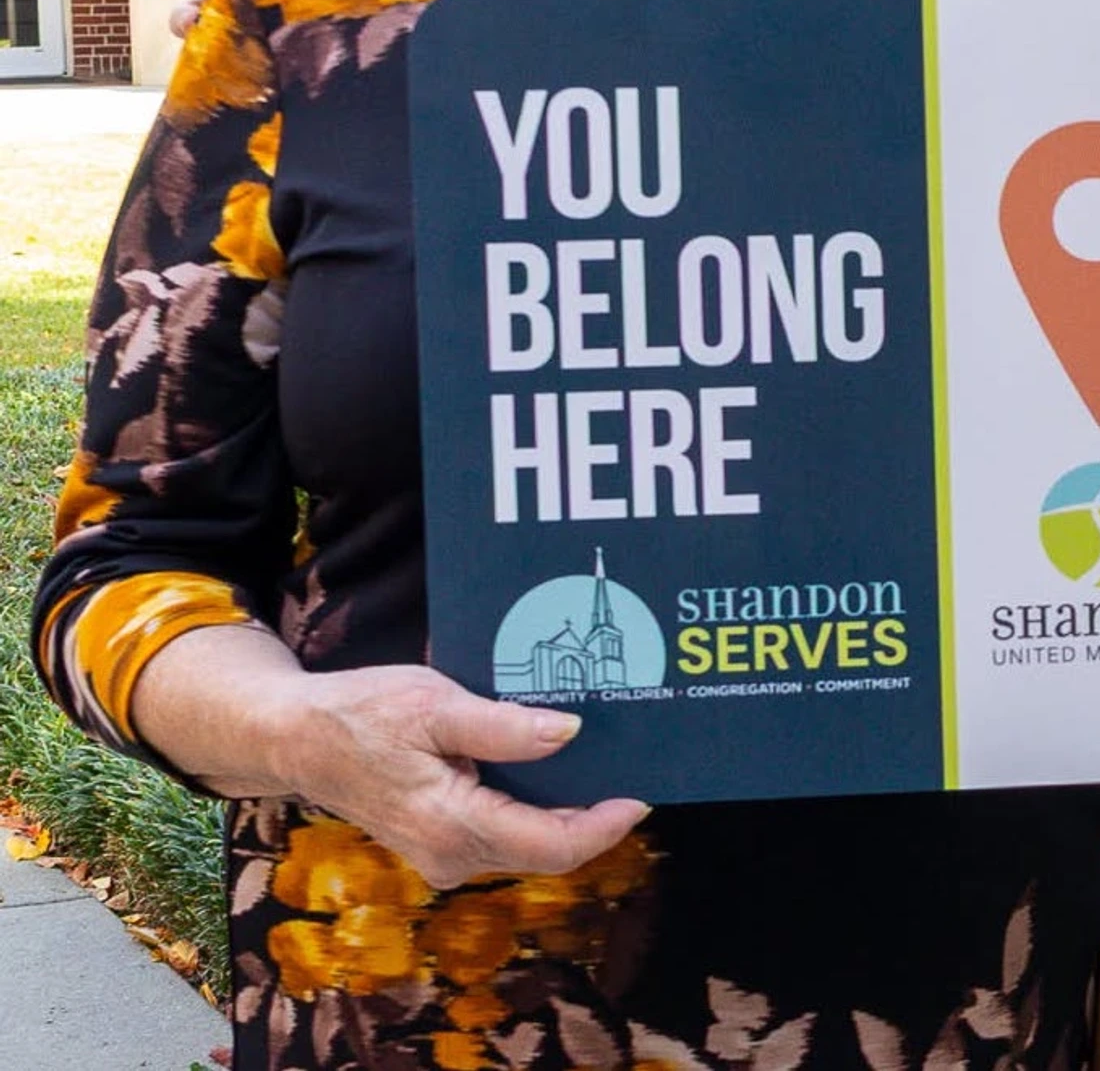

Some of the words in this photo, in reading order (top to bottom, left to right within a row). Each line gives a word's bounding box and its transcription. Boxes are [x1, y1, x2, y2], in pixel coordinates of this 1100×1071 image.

[473, 86, 682, 220] YOU
[485, 231, 886, 372] BELONG
[491, 386, 761, 523] HERE
[601, 687, 674, 701] CHILDREN
[687, 682, 803, 698] CONGREGATION
[815, 677, 911, 692] COMMITMENT
[677, 618, 908, 674] SERVES
[992, 646, 1076, 666] UNITED
